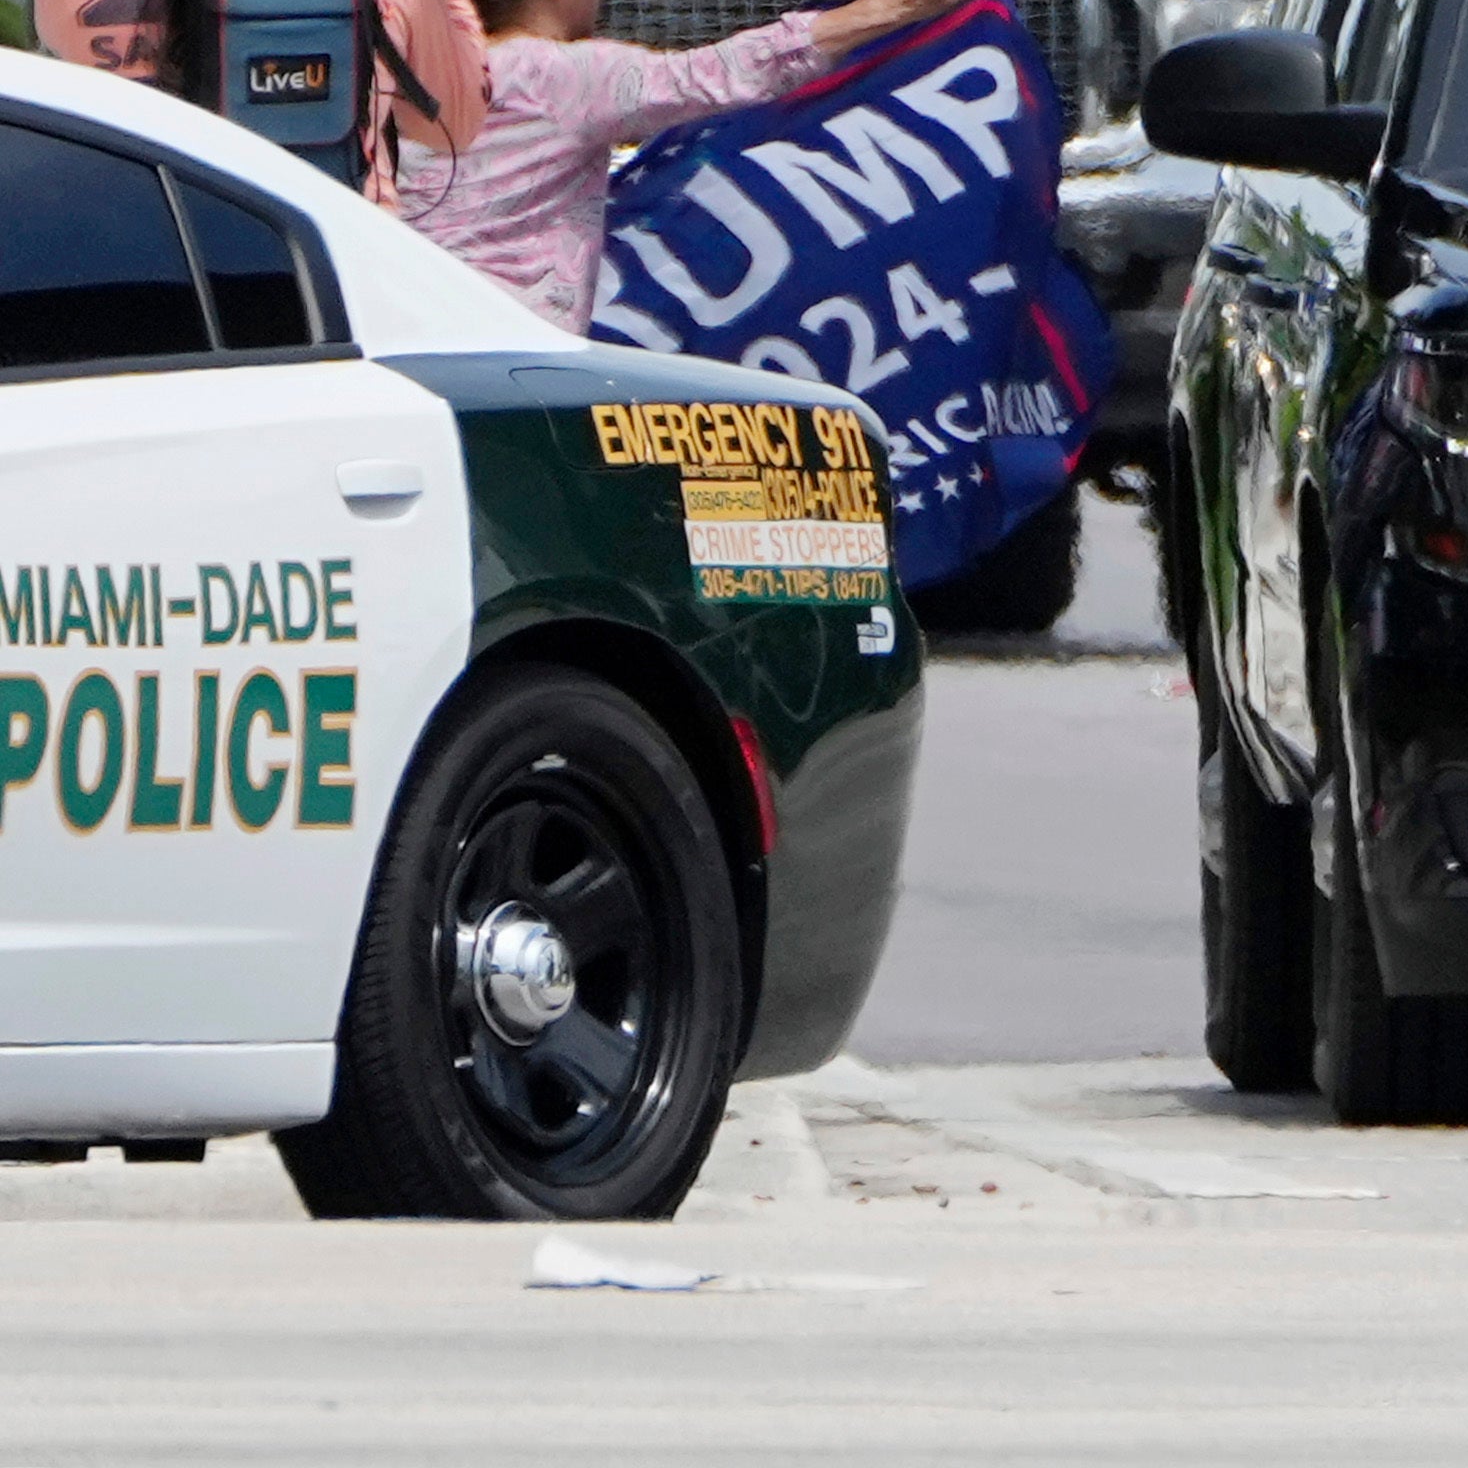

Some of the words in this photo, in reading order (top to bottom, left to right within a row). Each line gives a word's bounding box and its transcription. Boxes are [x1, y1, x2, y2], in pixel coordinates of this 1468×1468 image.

[591, 403, 803, 468] EMERGENCY
[812, 405, 873, 469] 911
[690, 524, 765, 563] CRIME
[768, 526, 888, 565] STOPPERS
[0, 557, 358, 648] MIAMI-DADE
[701, 568, 829, 600] 305-471-TIPS
[833, 571, 886, 601] (8477)
[0, 666, 359, 836] POLICE
